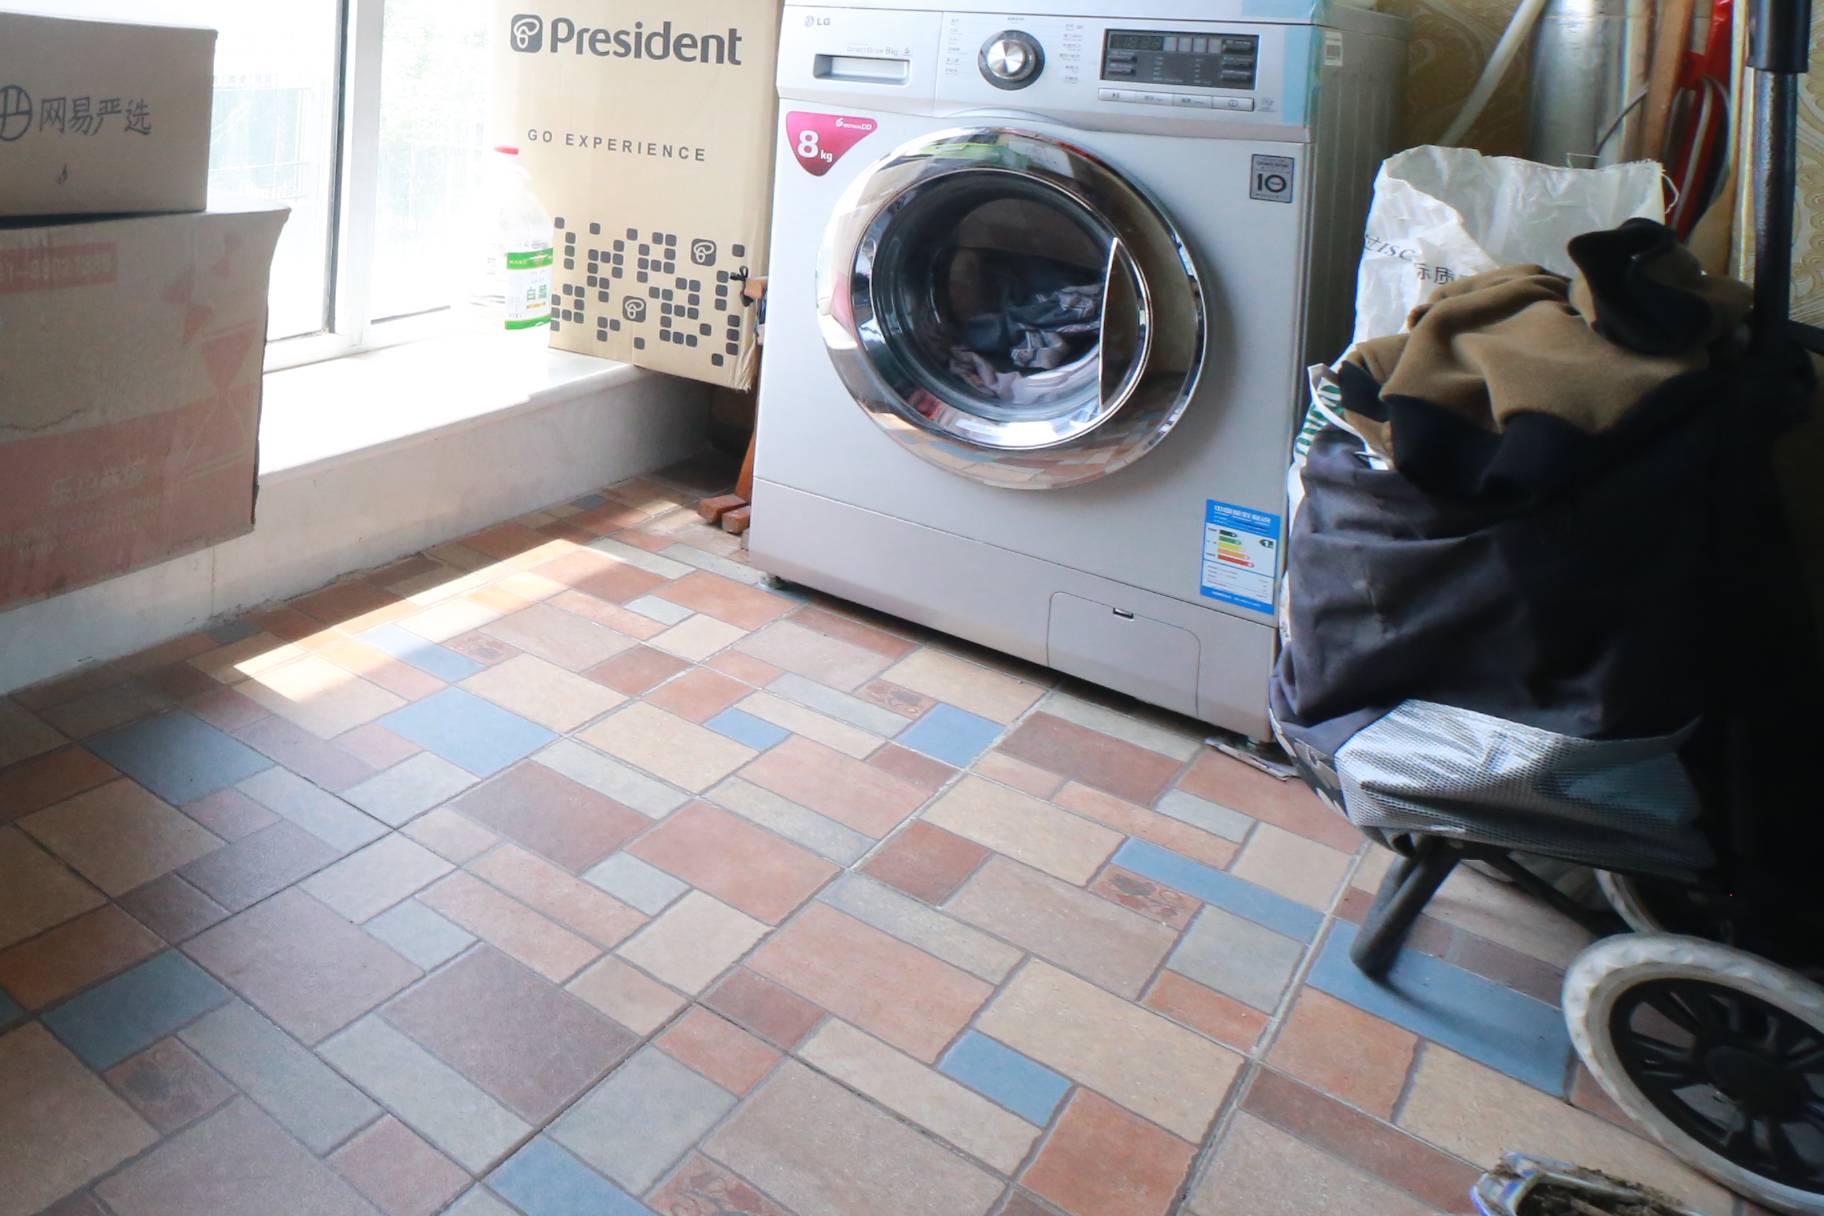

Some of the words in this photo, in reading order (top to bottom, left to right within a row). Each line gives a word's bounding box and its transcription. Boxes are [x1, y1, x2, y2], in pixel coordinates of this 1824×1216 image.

[816, 17, 831, 27] LG
[550, 16, 743, 66] President
[39, 96, 153, 136] 网易严选
[528, 128, 553, 144] GO
[565, 132, 707, 162] EXPERIENCE
[797, 130, 819, 158] 8
[820, 148, 833, 163] kg
